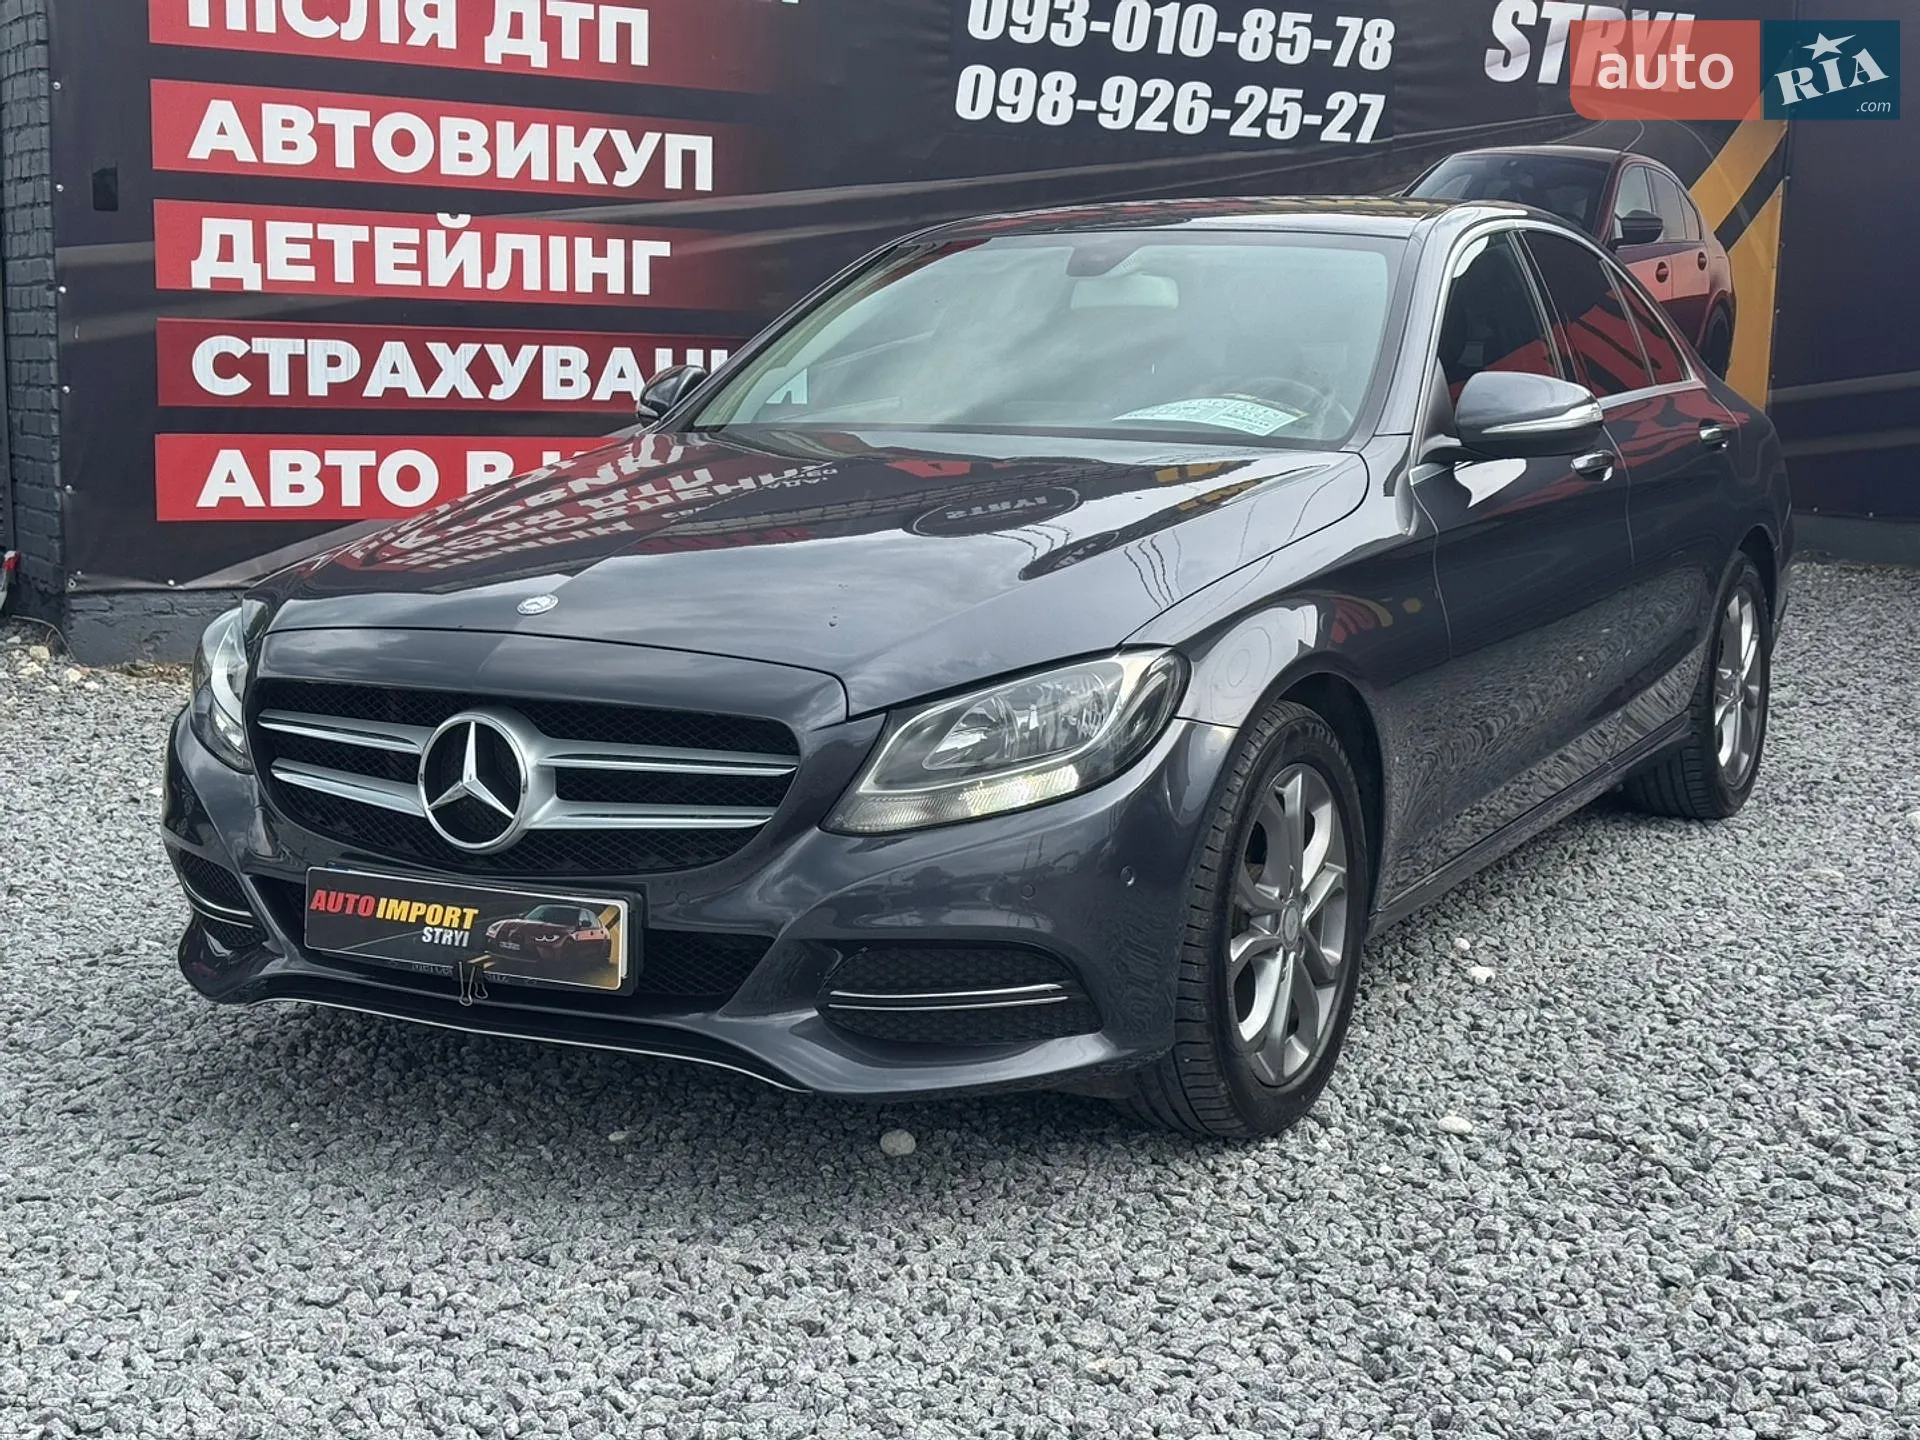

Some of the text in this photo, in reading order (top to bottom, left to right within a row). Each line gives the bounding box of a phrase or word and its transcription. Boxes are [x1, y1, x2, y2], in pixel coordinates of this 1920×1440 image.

[484, 0, 650, 68] ДТП
[967, 0, 1395, 71] 093-010-85-78
[954, 64, 1386, 144] 098-926-25-27
[188, 99, 715, 192] АВТОВИКУП
[190, 212, 672, 297] ДЕТЕЙЛІНГ
[196, 449, 440, 509] АВТО
[421, 926, 470, 947] STRYI
